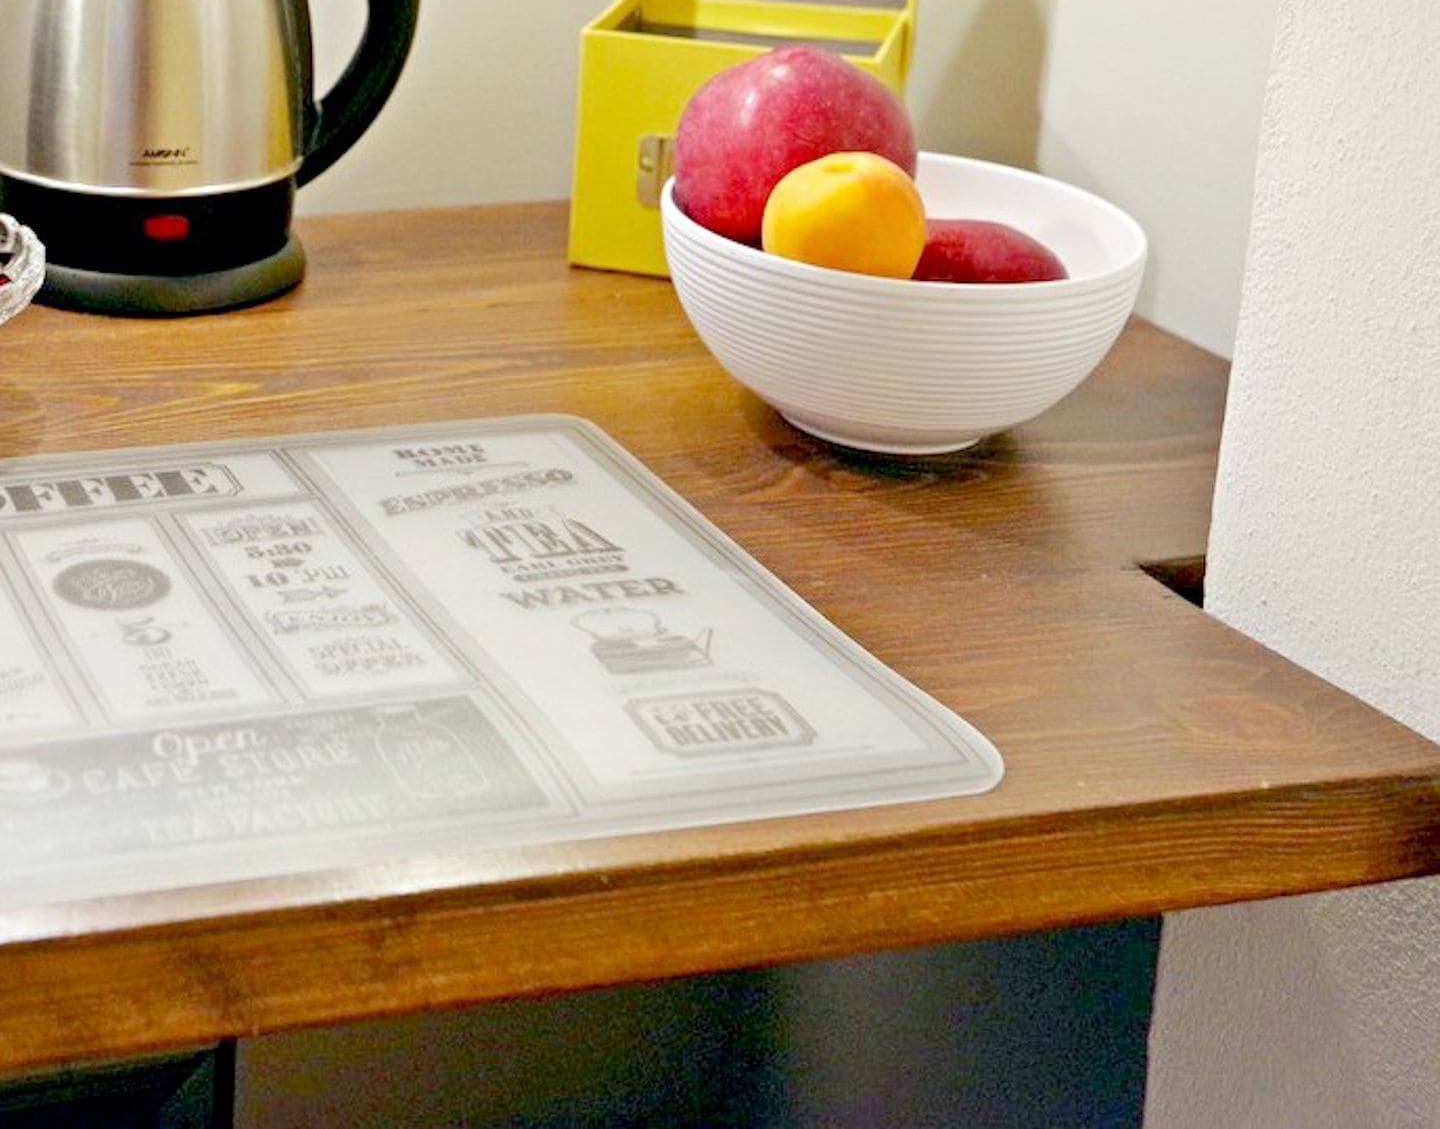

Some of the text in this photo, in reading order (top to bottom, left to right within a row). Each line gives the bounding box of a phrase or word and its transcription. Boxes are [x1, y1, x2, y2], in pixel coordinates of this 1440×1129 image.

[392, 443, 486, 460] HOME
[413, 454, 488, 468] MADE
[377, 467, 575, 518] ESPRESSO
[456, 517, 625, 564] TEA
[248, 571, 290, 588] 10
[497, 575, 689, 610] WATER
[690, 697, 776, 722] FREE
[151, 727, 268, 768] Open
[663, 716, 792, 748] DELIVERY
[222, 738, 362, 779] STORE
